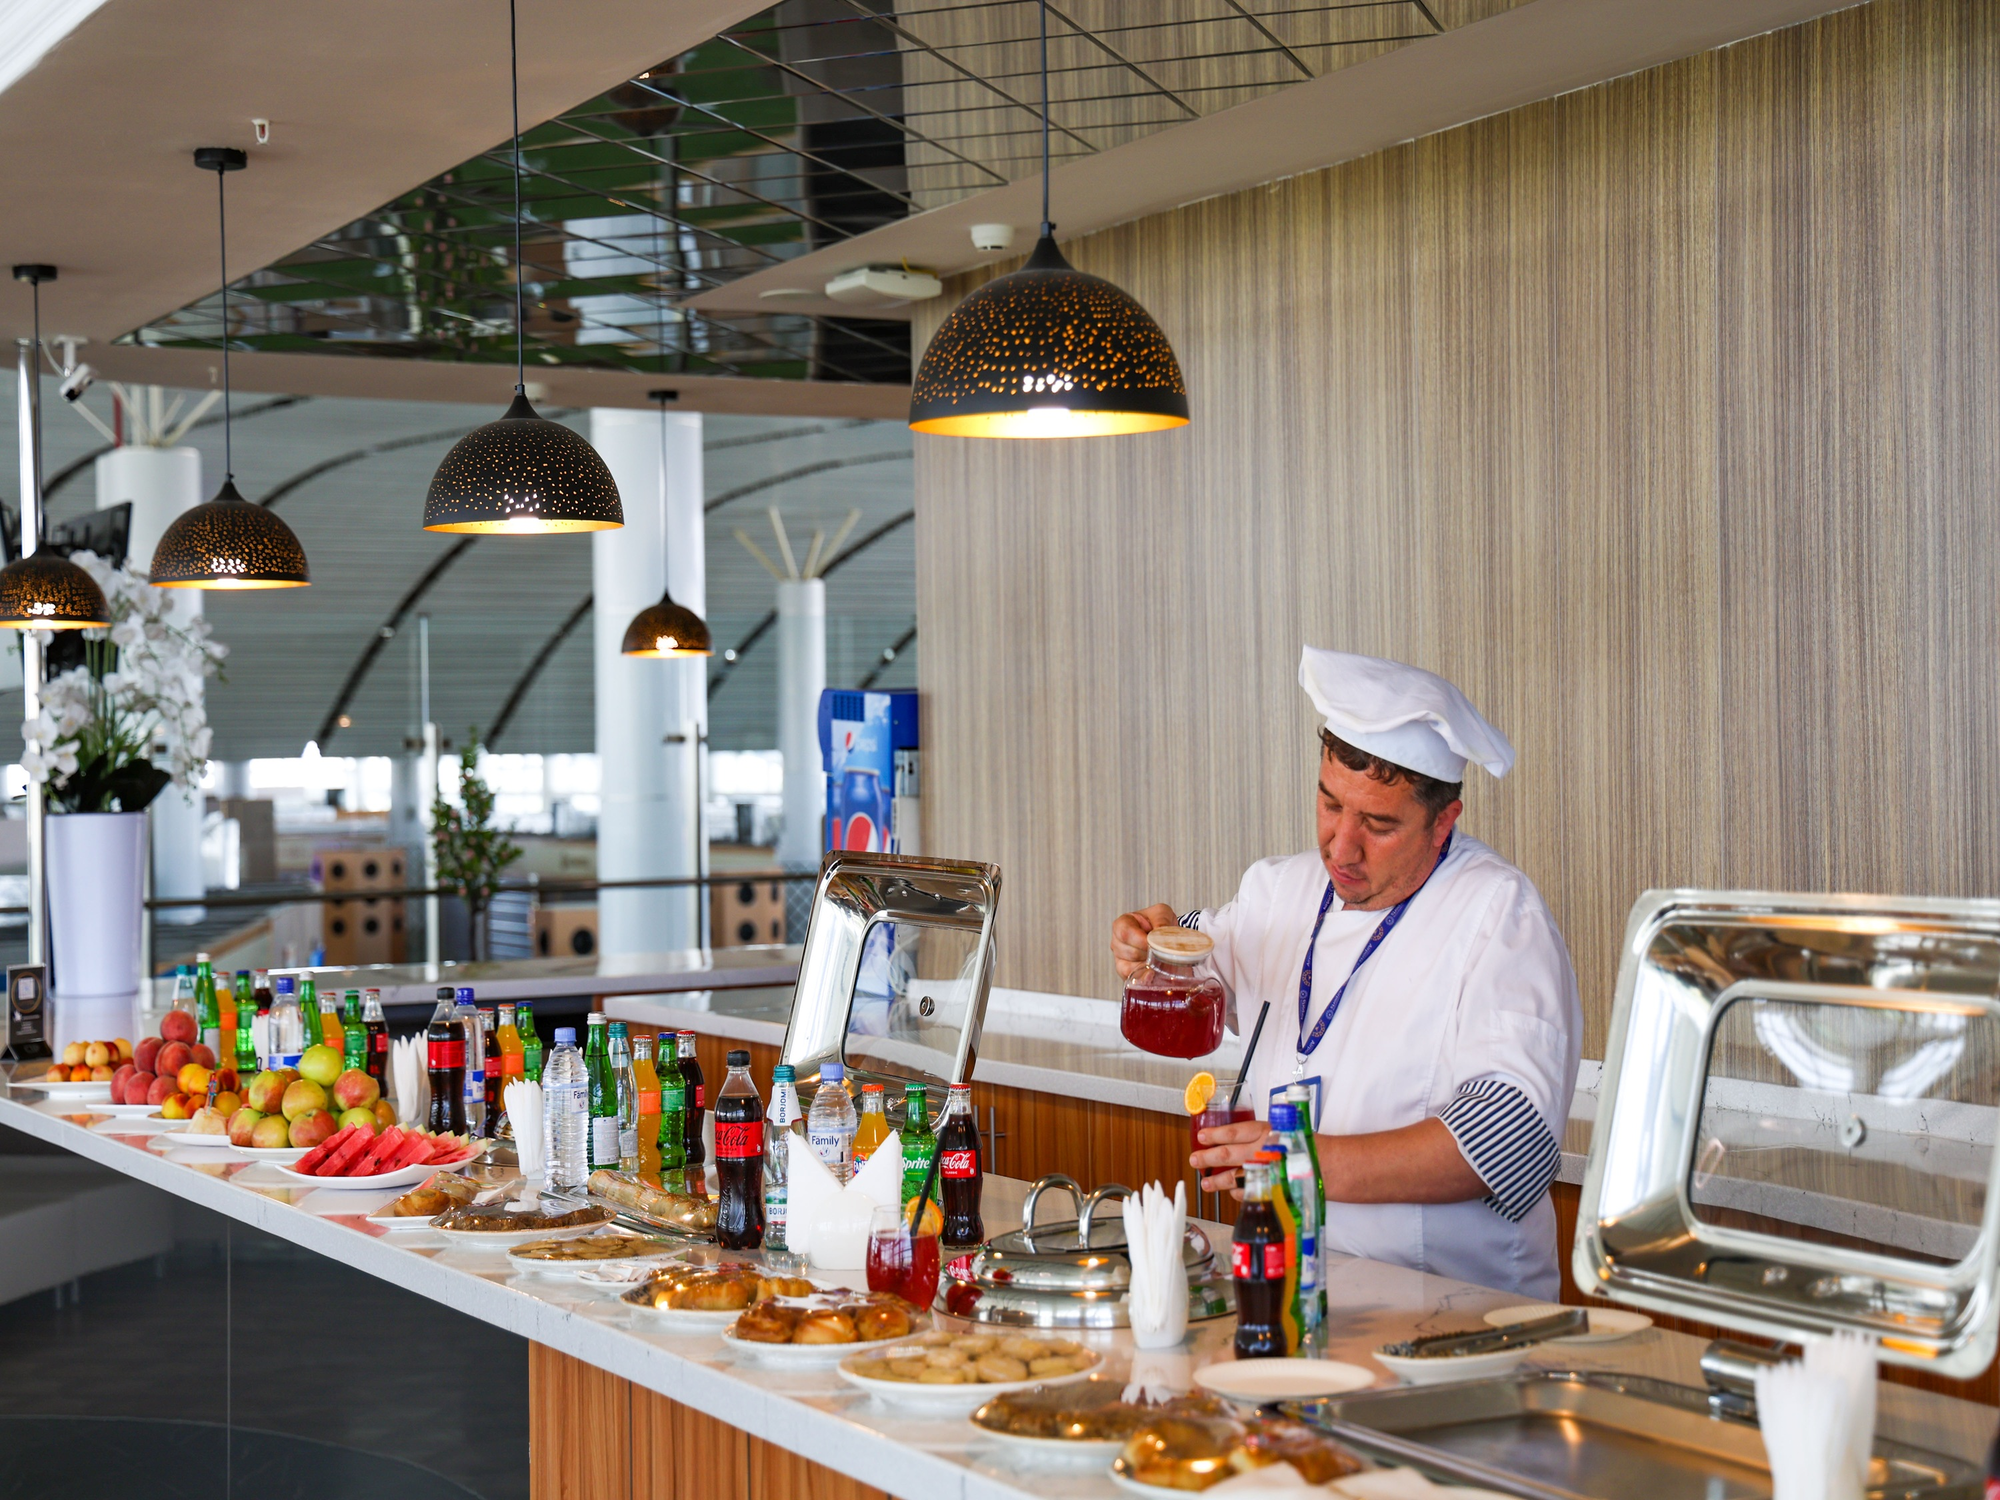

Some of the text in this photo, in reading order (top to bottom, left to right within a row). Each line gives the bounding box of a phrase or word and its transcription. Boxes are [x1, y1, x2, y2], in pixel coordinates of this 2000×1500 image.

[811, 1135, 840, 1148] Family
[902, 1156, 931, 1172] Sprite
[769, 1207, 788, 1216] BORJ
